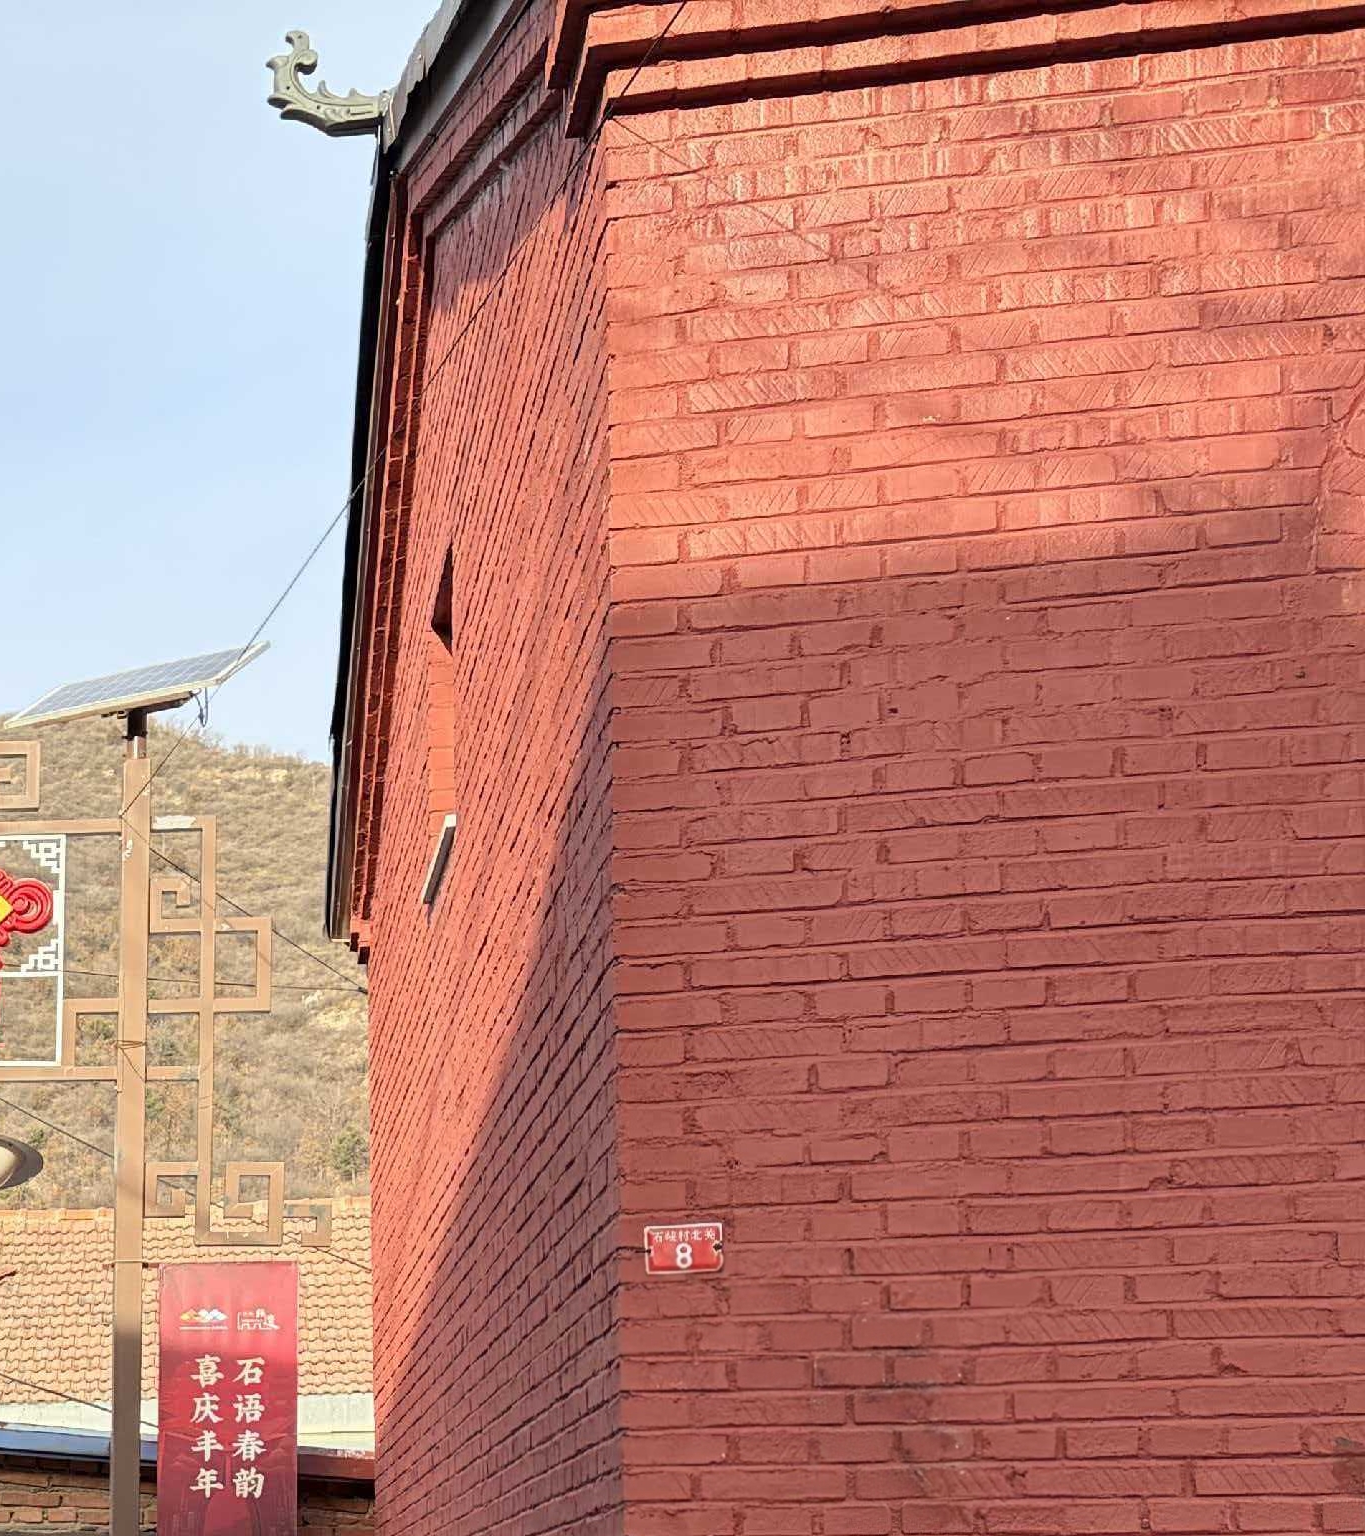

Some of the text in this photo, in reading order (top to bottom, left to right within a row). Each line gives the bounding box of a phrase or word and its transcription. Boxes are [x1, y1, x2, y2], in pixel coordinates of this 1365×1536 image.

[676, 1242, 693, 1269] 8
[189, 1354, 224, 1499] 喜庆丰年
[232, 1357, 267, 1499] 石语春韵
